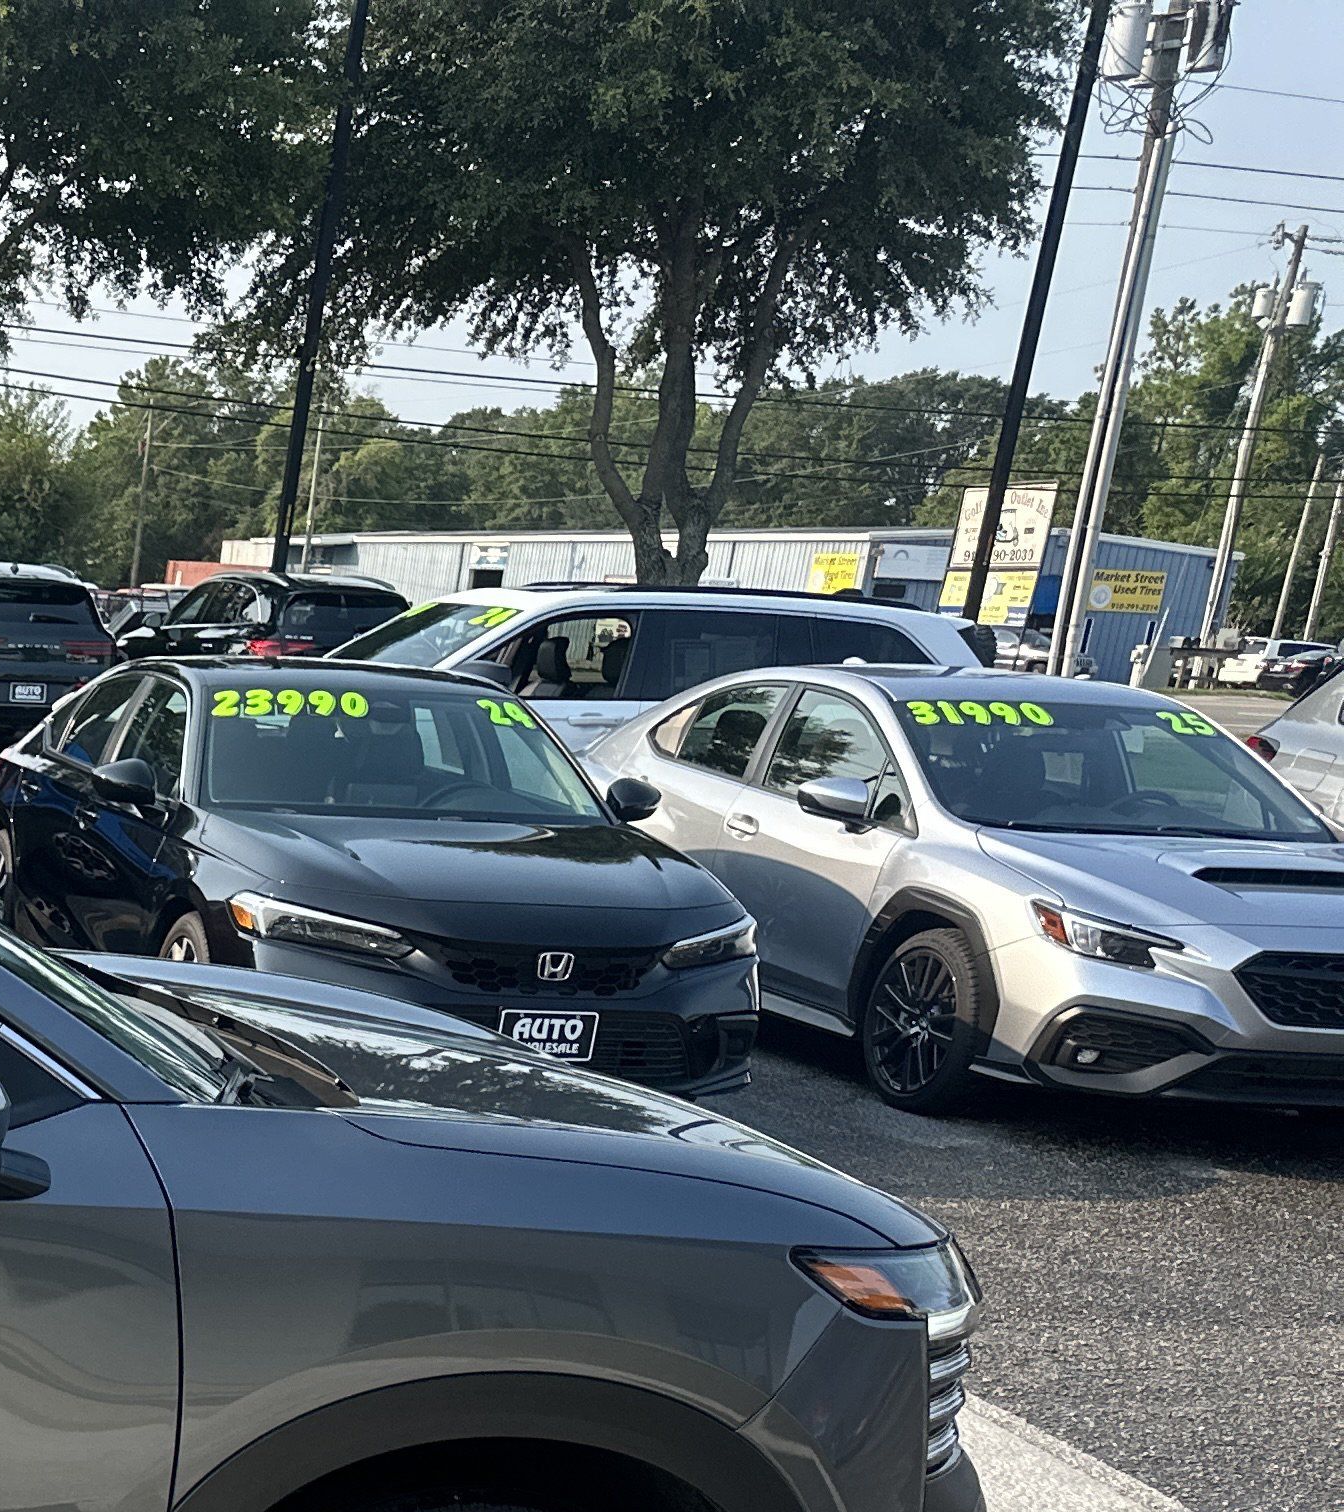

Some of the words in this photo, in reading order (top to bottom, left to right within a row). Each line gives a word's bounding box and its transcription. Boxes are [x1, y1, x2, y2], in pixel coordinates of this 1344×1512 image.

[1094, 571, 1131, 583] Market
[1133, 572, 1165, 584] Street
[1113, 584, 1138, 594] Used
[1139, 585, 1163, 596] Tires
[15, 685, 42, 695] AUTO
[211, 688, 369, 719] 23990
[906, 700, 1055, 727] 31990
[1155, 711, 1218, 738] 25
[512, 1017, 584, 1041] AUTO
[527, 1041, 580, 1055] OLESALE
